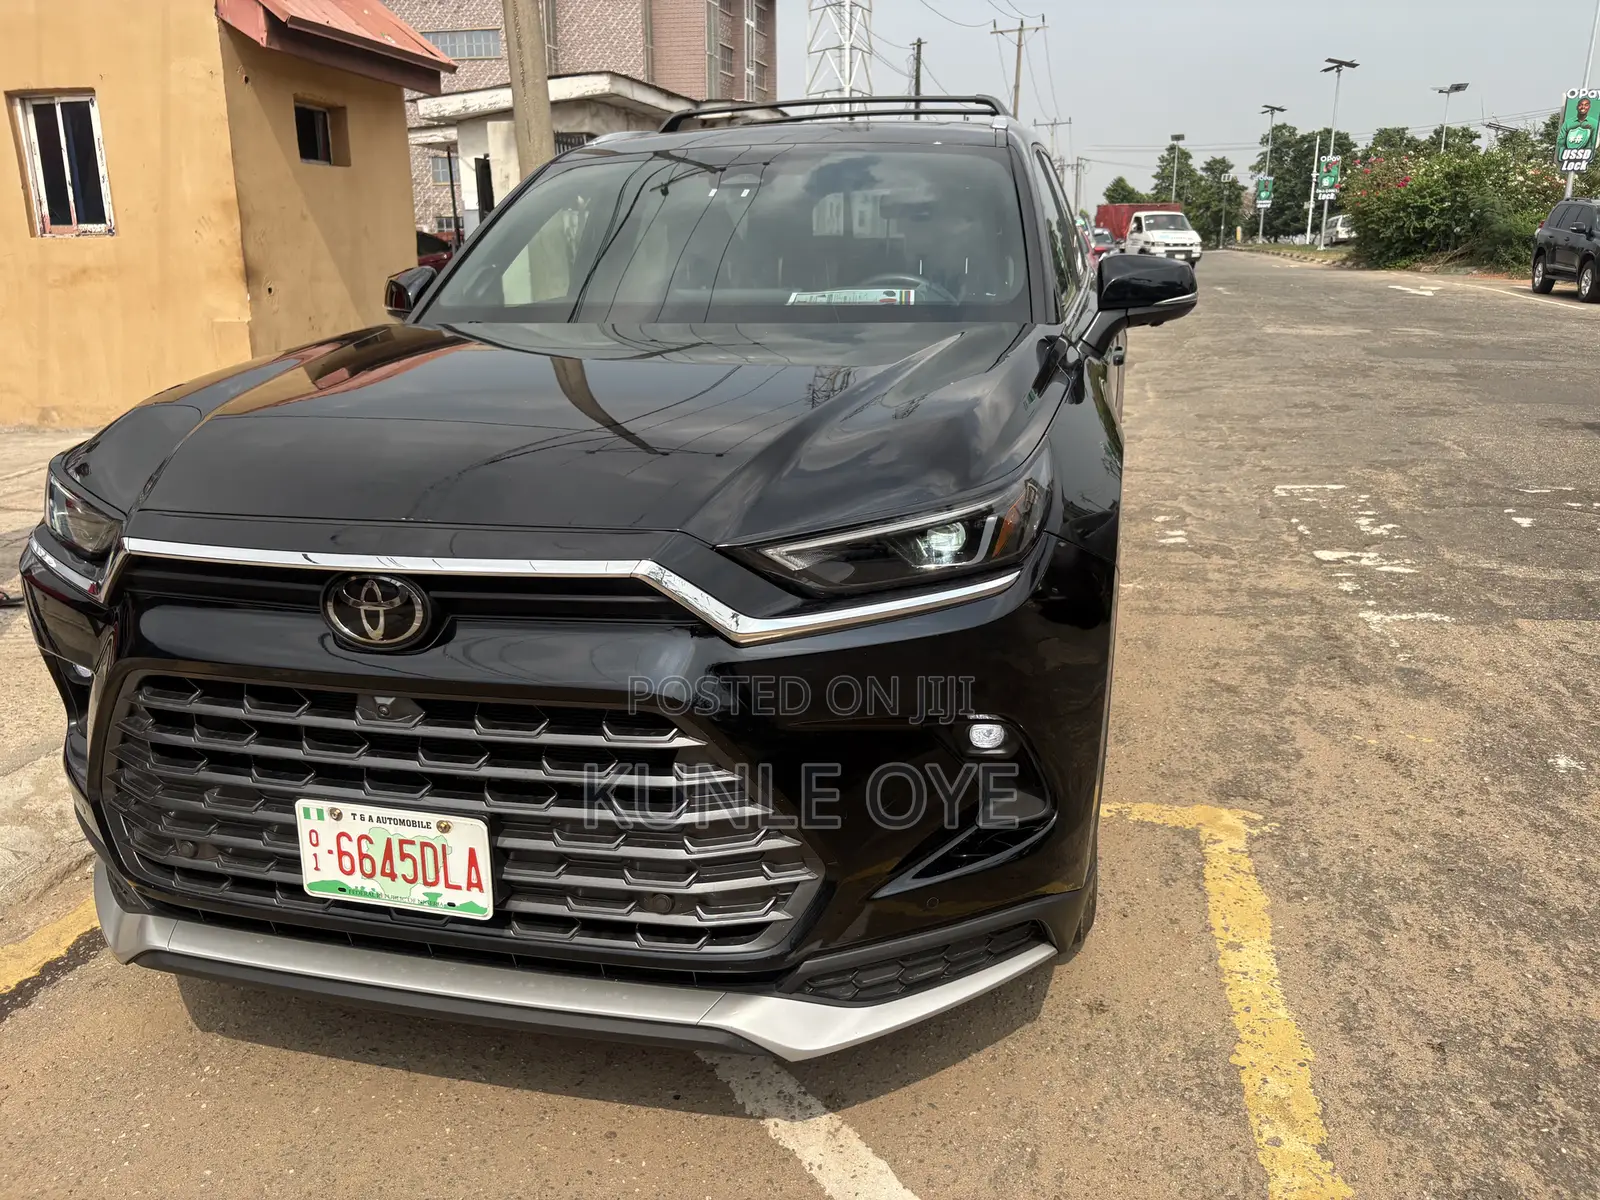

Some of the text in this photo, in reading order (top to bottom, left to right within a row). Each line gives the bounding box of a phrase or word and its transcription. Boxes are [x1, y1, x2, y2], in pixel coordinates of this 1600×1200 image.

[1562, 149, 1592, 160] USSD
[1561, 160, 1589, 171] Lock
[351, 813, 432, 830] T & A AUTOMOBILE
